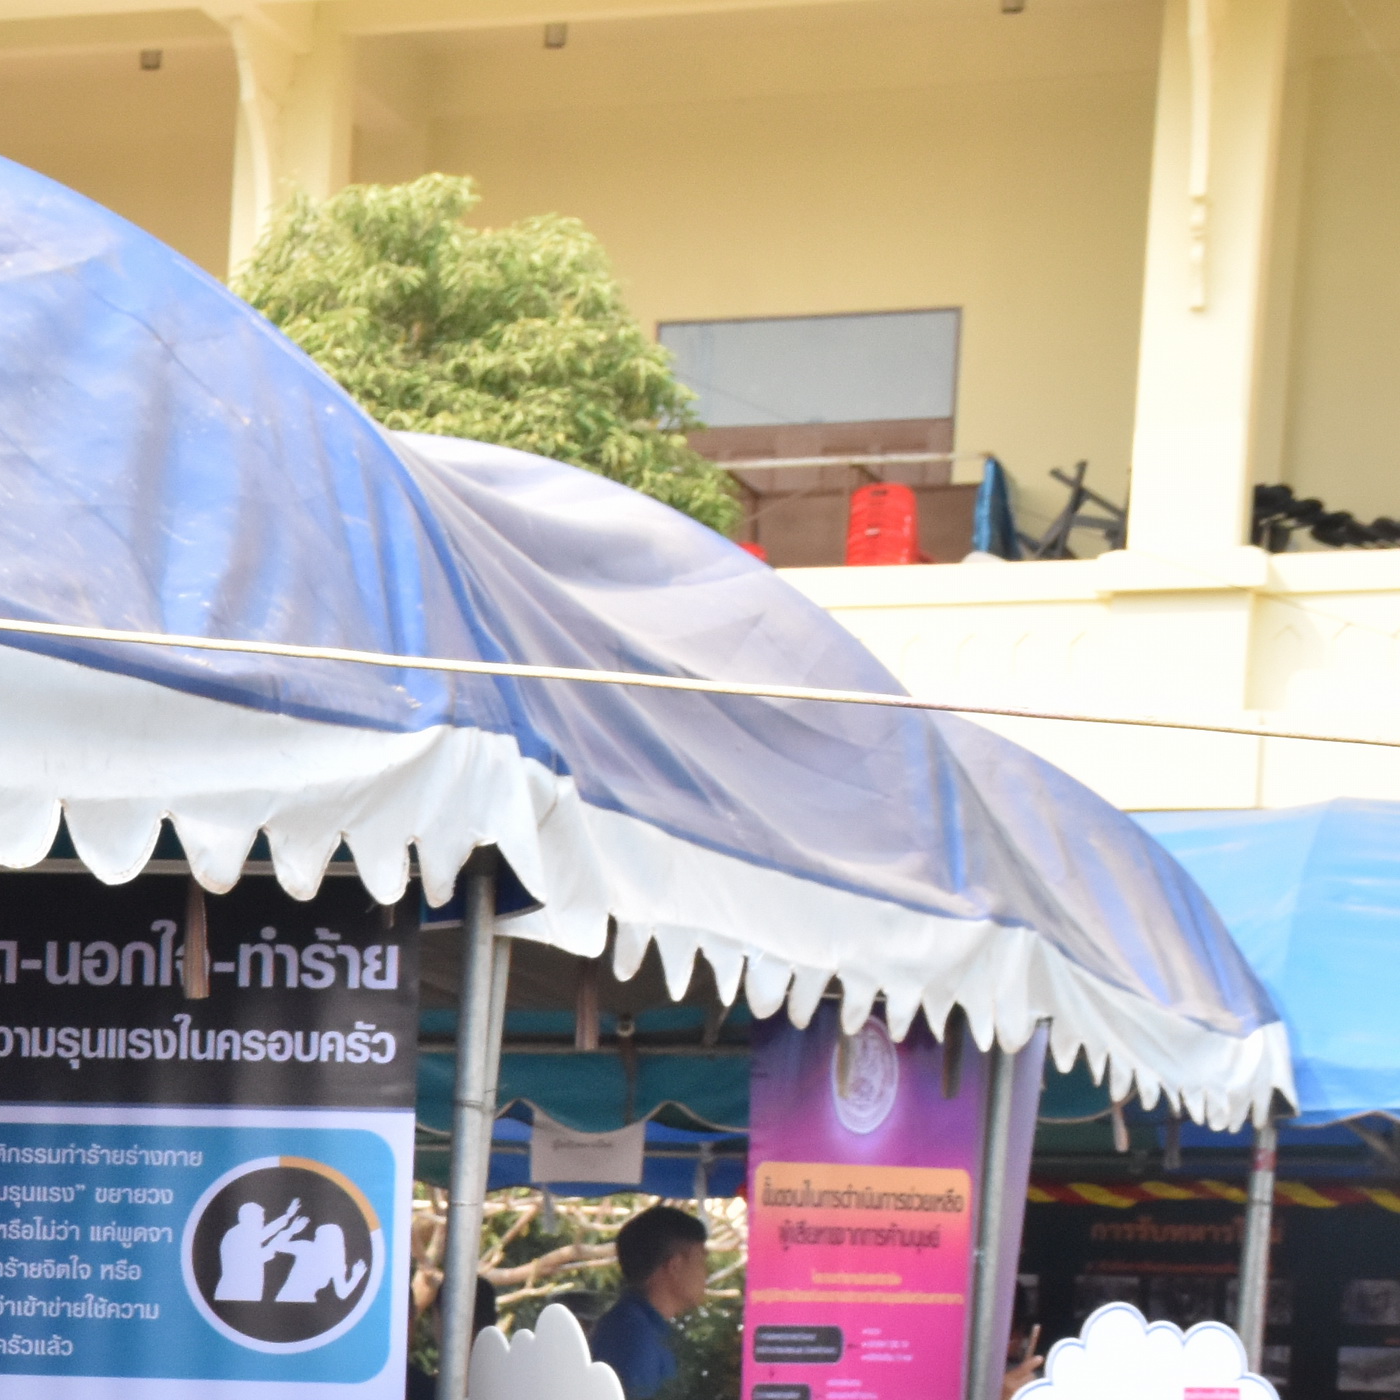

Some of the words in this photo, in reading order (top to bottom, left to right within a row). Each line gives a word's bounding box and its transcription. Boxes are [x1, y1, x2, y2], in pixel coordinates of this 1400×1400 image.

[95, 1188, 174, 1204] ขยายวง
[90, 1221, 173, 1248] แค่พูดจา
[100, 1260, 142, 1281] หรือ
